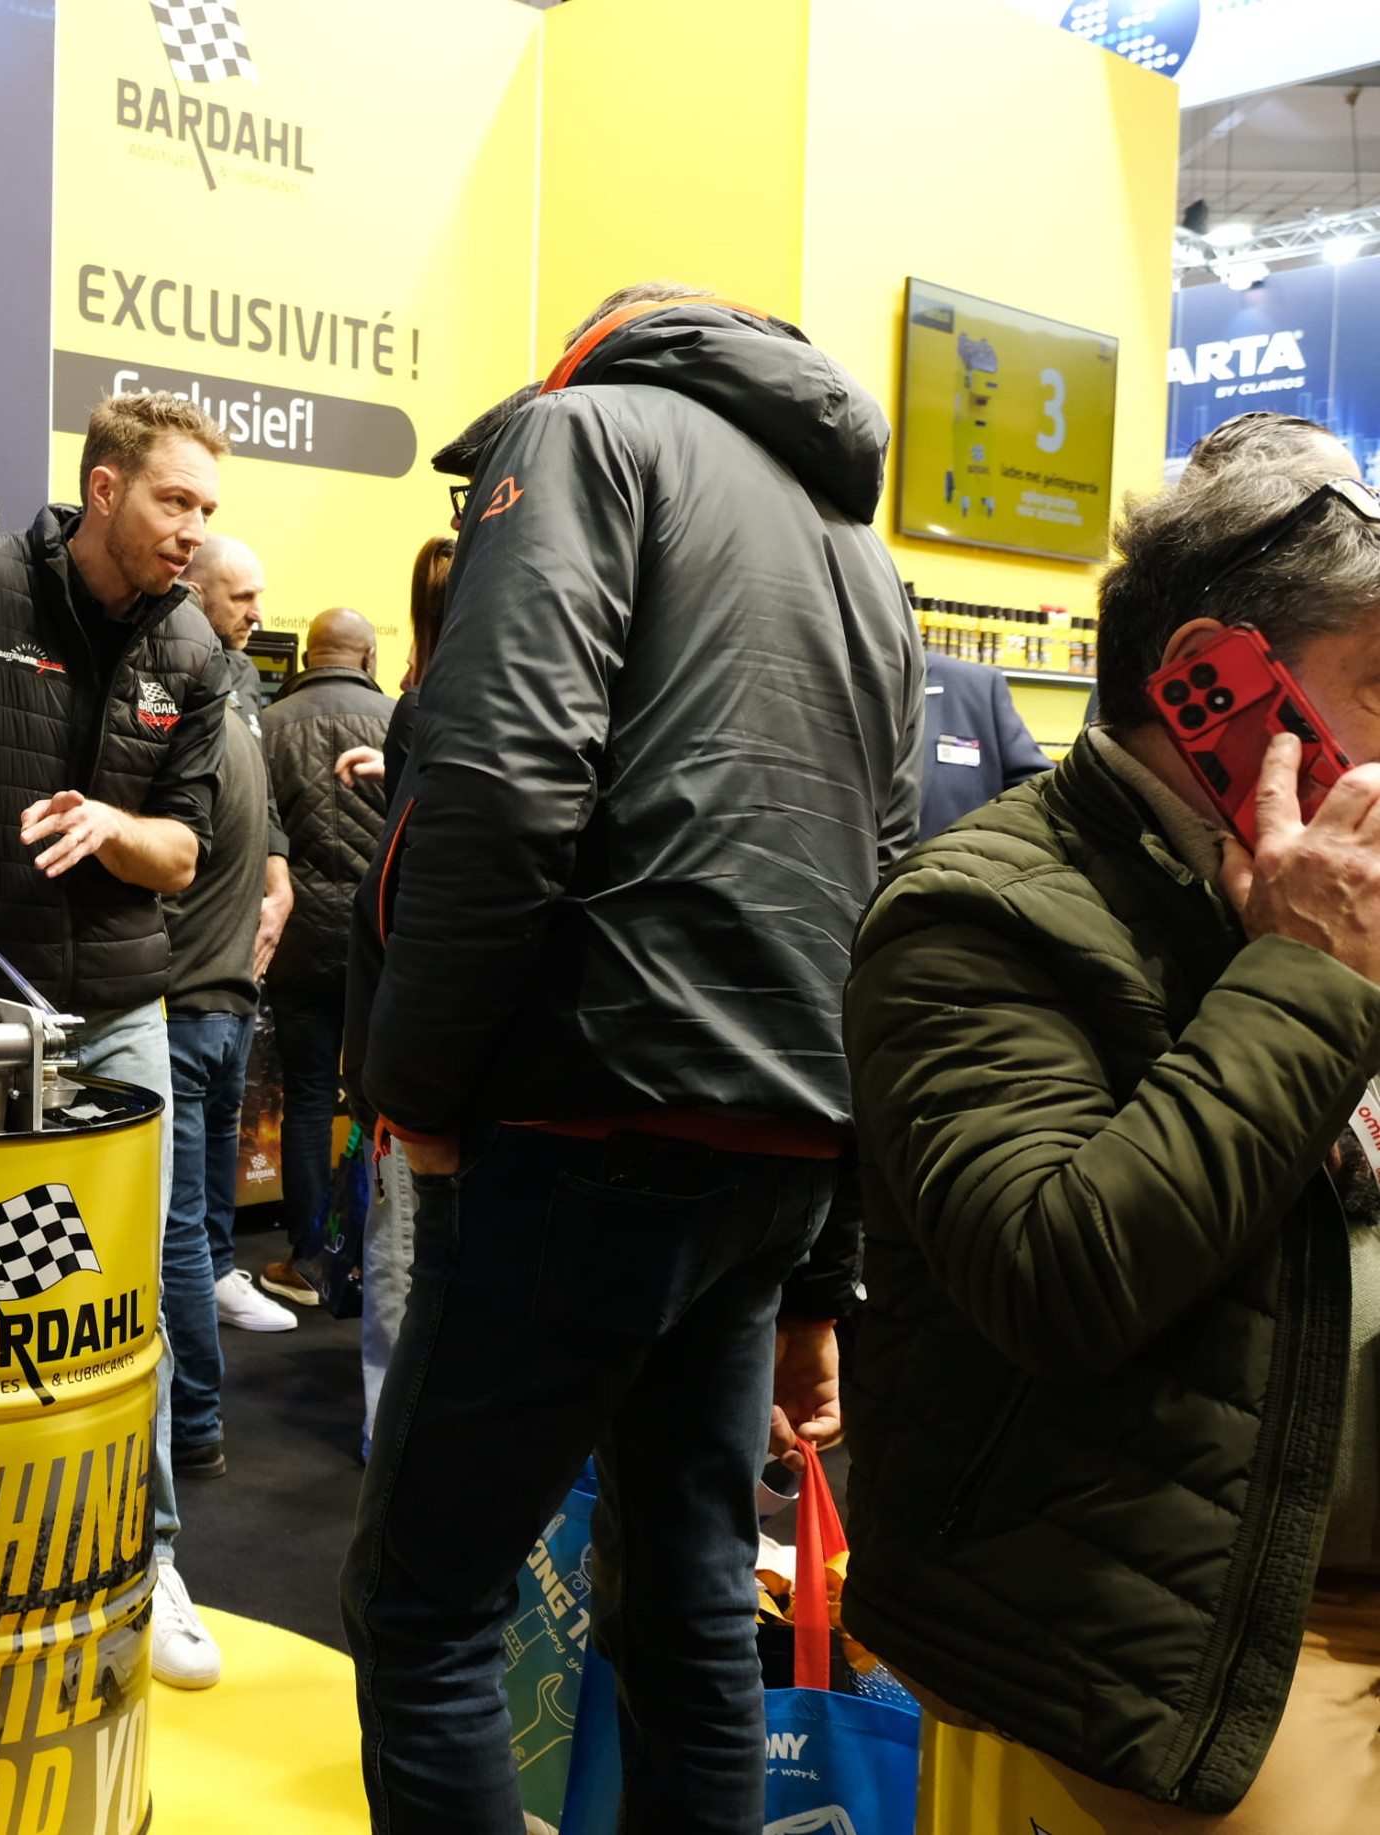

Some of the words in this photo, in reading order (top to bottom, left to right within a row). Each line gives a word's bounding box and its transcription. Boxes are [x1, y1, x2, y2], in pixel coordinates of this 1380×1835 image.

[117, 78, 314, 176] BARDAHL
[78, 263, 394, 377] EXCLUSIVITÉ
[410, 328, 420, 380] !
[1166, 330, 1307, 386] ARTA
[112, 370, 314, 453] Eusief!
[1035, 368, 1066, 454] 3
[373, 623, 399, 637] icule
[51, 1373, 64, 1388] &
[66, 1351, 136, 1386] LUBRICANTS
[536, 1604, 567, 1654] Enjoy
[93, 1699, 147, 1835] YO
[766, 1732, 809, 1761] NY
[781, 1768, 821, 1781] work
